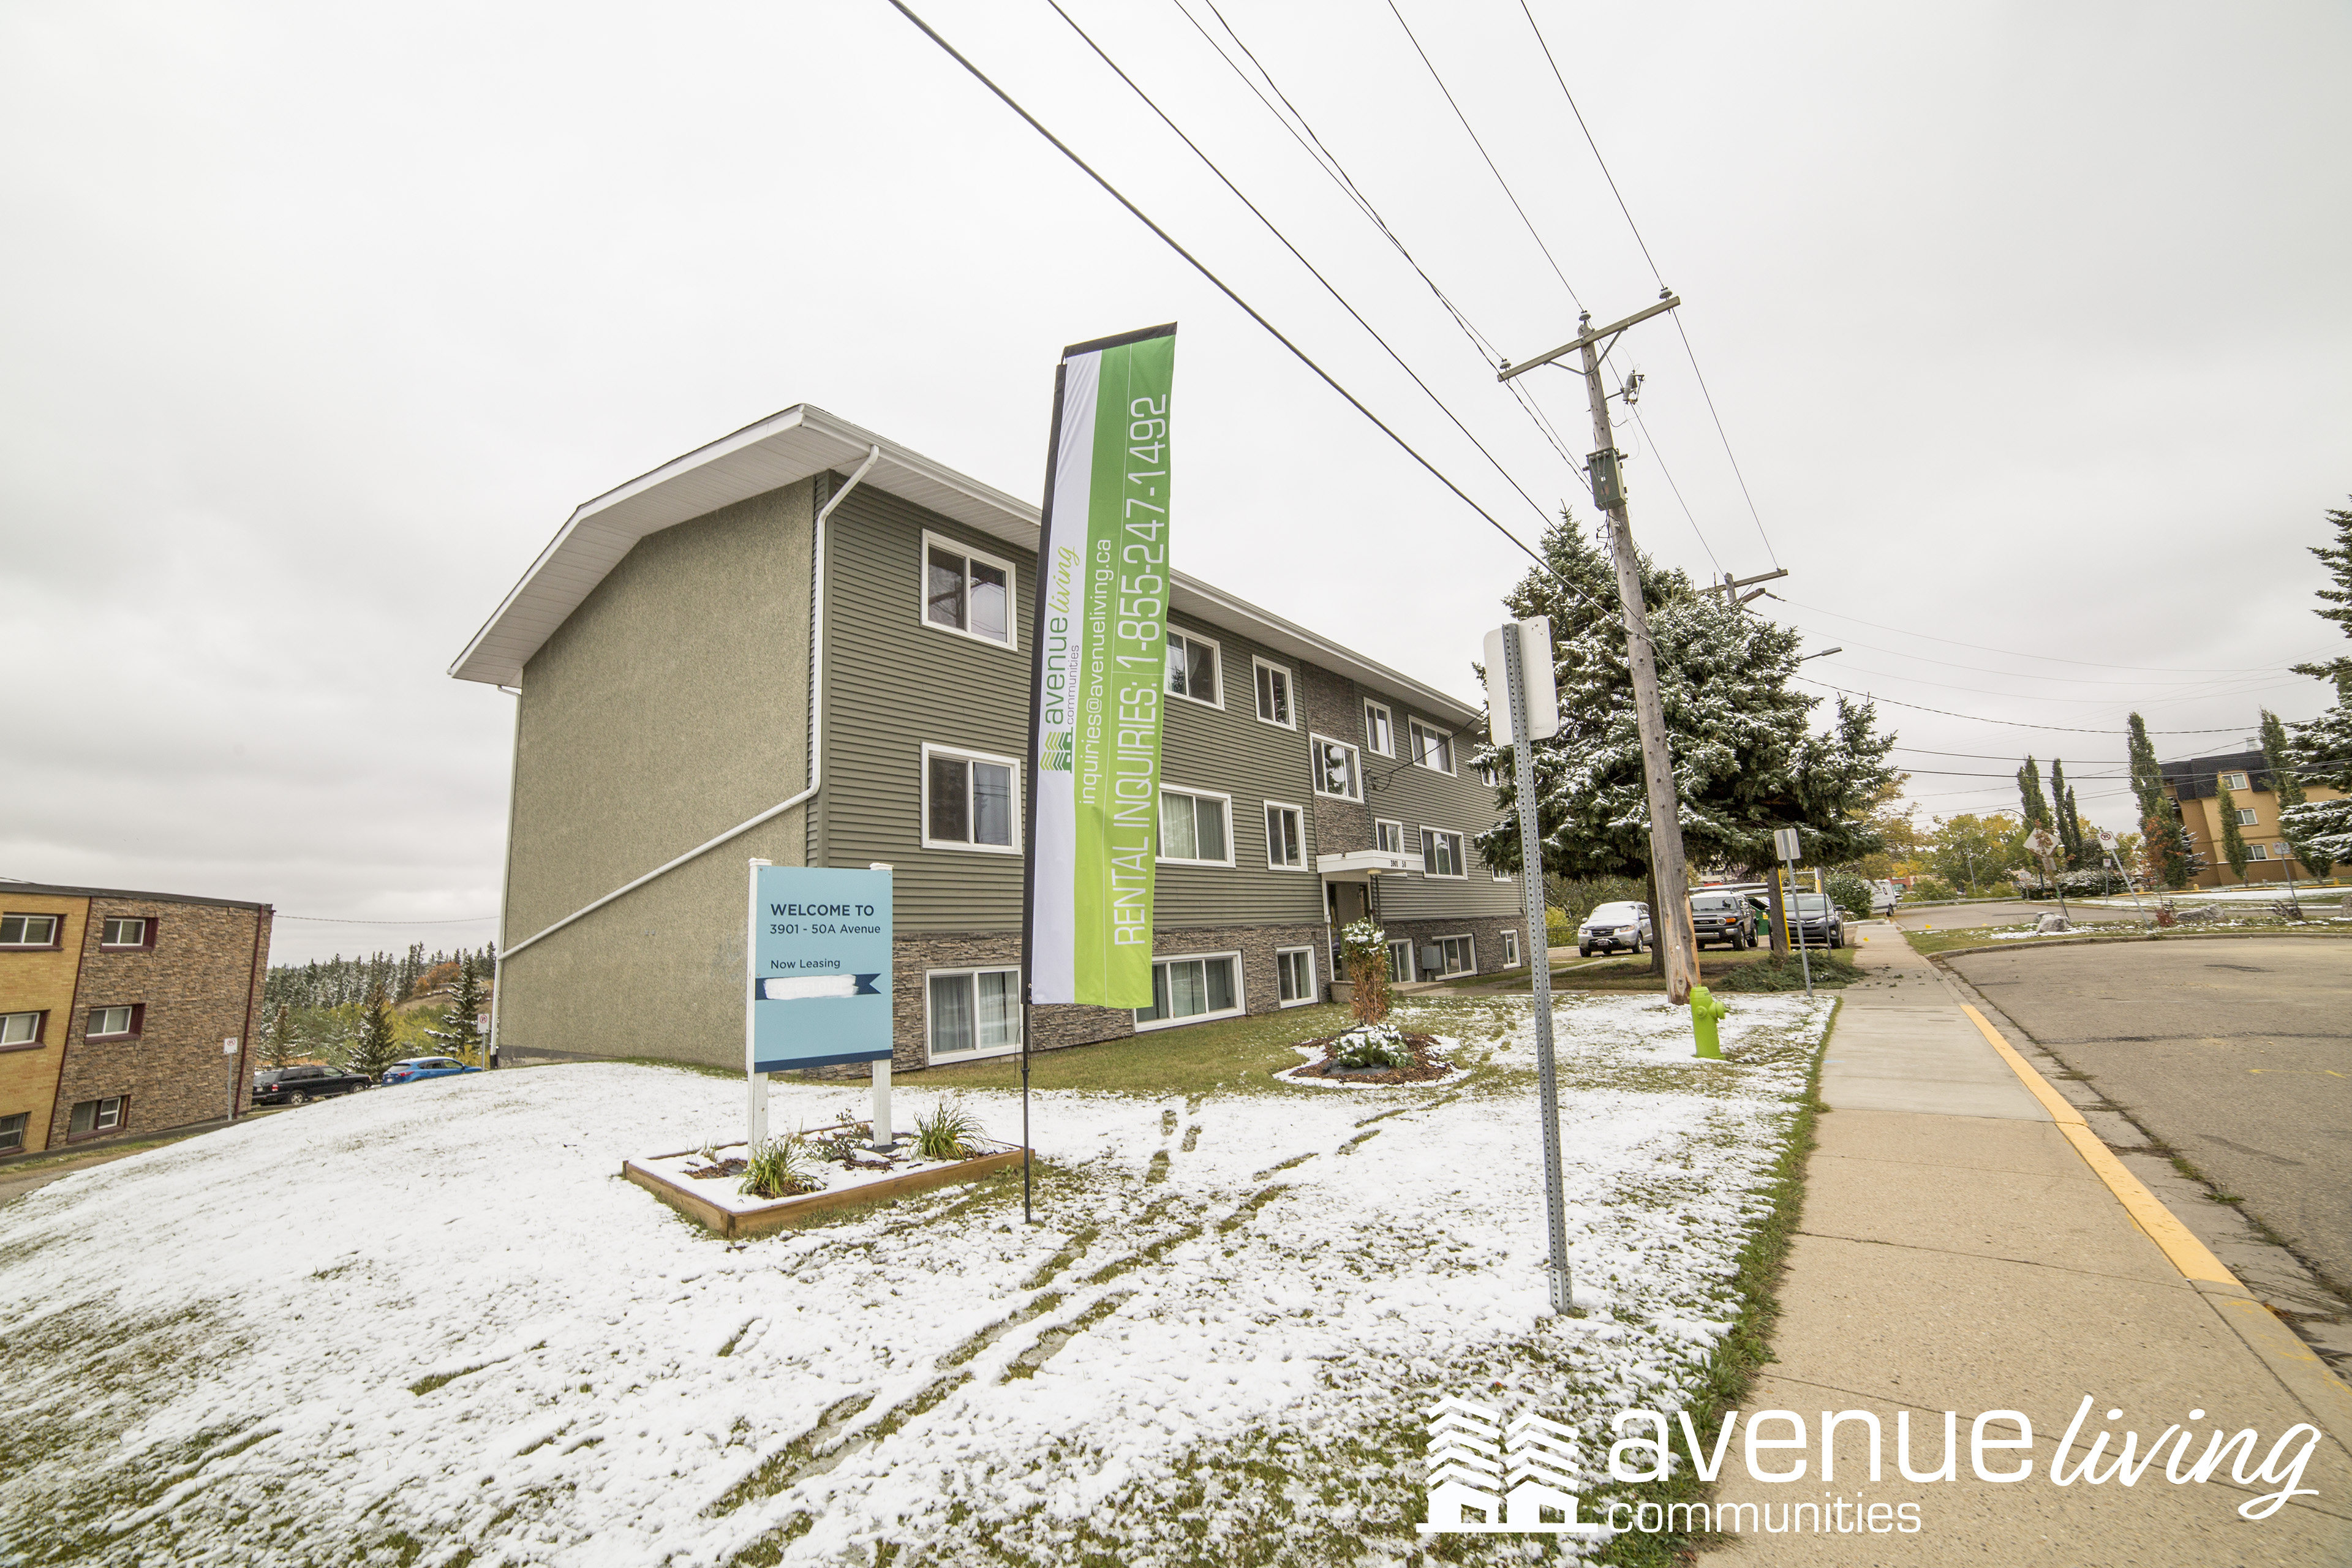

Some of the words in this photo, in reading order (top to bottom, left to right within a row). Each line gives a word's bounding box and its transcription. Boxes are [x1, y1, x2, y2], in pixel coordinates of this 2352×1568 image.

[1116, 394, 1166, 669] 1-855-247-1492
[1048, 546, 1080, 614] living
[1045, 617, 1068, 725] avenue
[1067, 644, 1079, 725] communities
[1079, 539, 1114, 804] inquiries@avenueliving.ca
[1113, 681, 1157, 827] INQUIRIES:
[769, 924, 799, 934] 3901
[812, 924, 836, 934] 50A
[840, 924, 881, 933] Avenue
[770, 903, 850, 916] WELCOME
[855, 905, 875, 916] TO
[1111, 836, 1149, 945] RENTAL
[771, 960, 796, 969] Now
[799, 959, 840, 969] Leasing
